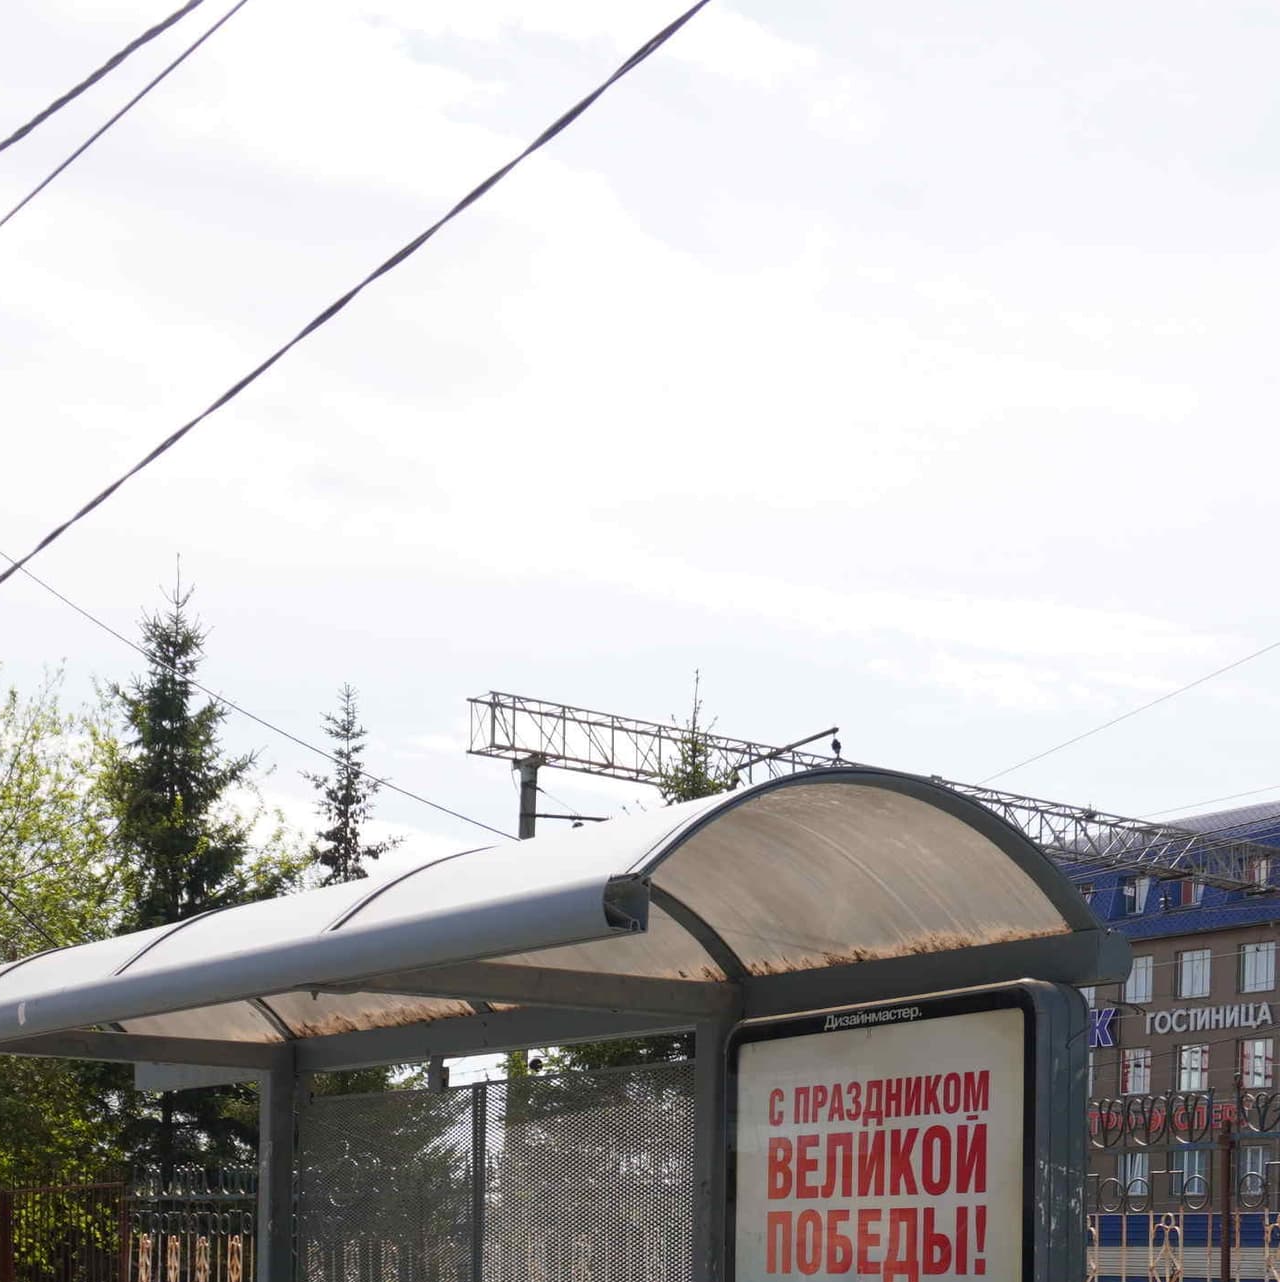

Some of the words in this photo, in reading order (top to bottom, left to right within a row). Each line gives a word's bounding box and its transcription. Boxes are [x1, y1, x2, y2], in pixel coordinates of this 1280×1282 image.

[1145, 1002, 1273, 1035] ГОСТИНИЦА
[768, 1087, 785, 1127] С
[793, 1070, 991, 1127] ПРАЗДНИКОМ
[767, 1115, 988, 1200] ВЕЛИКОЙ
